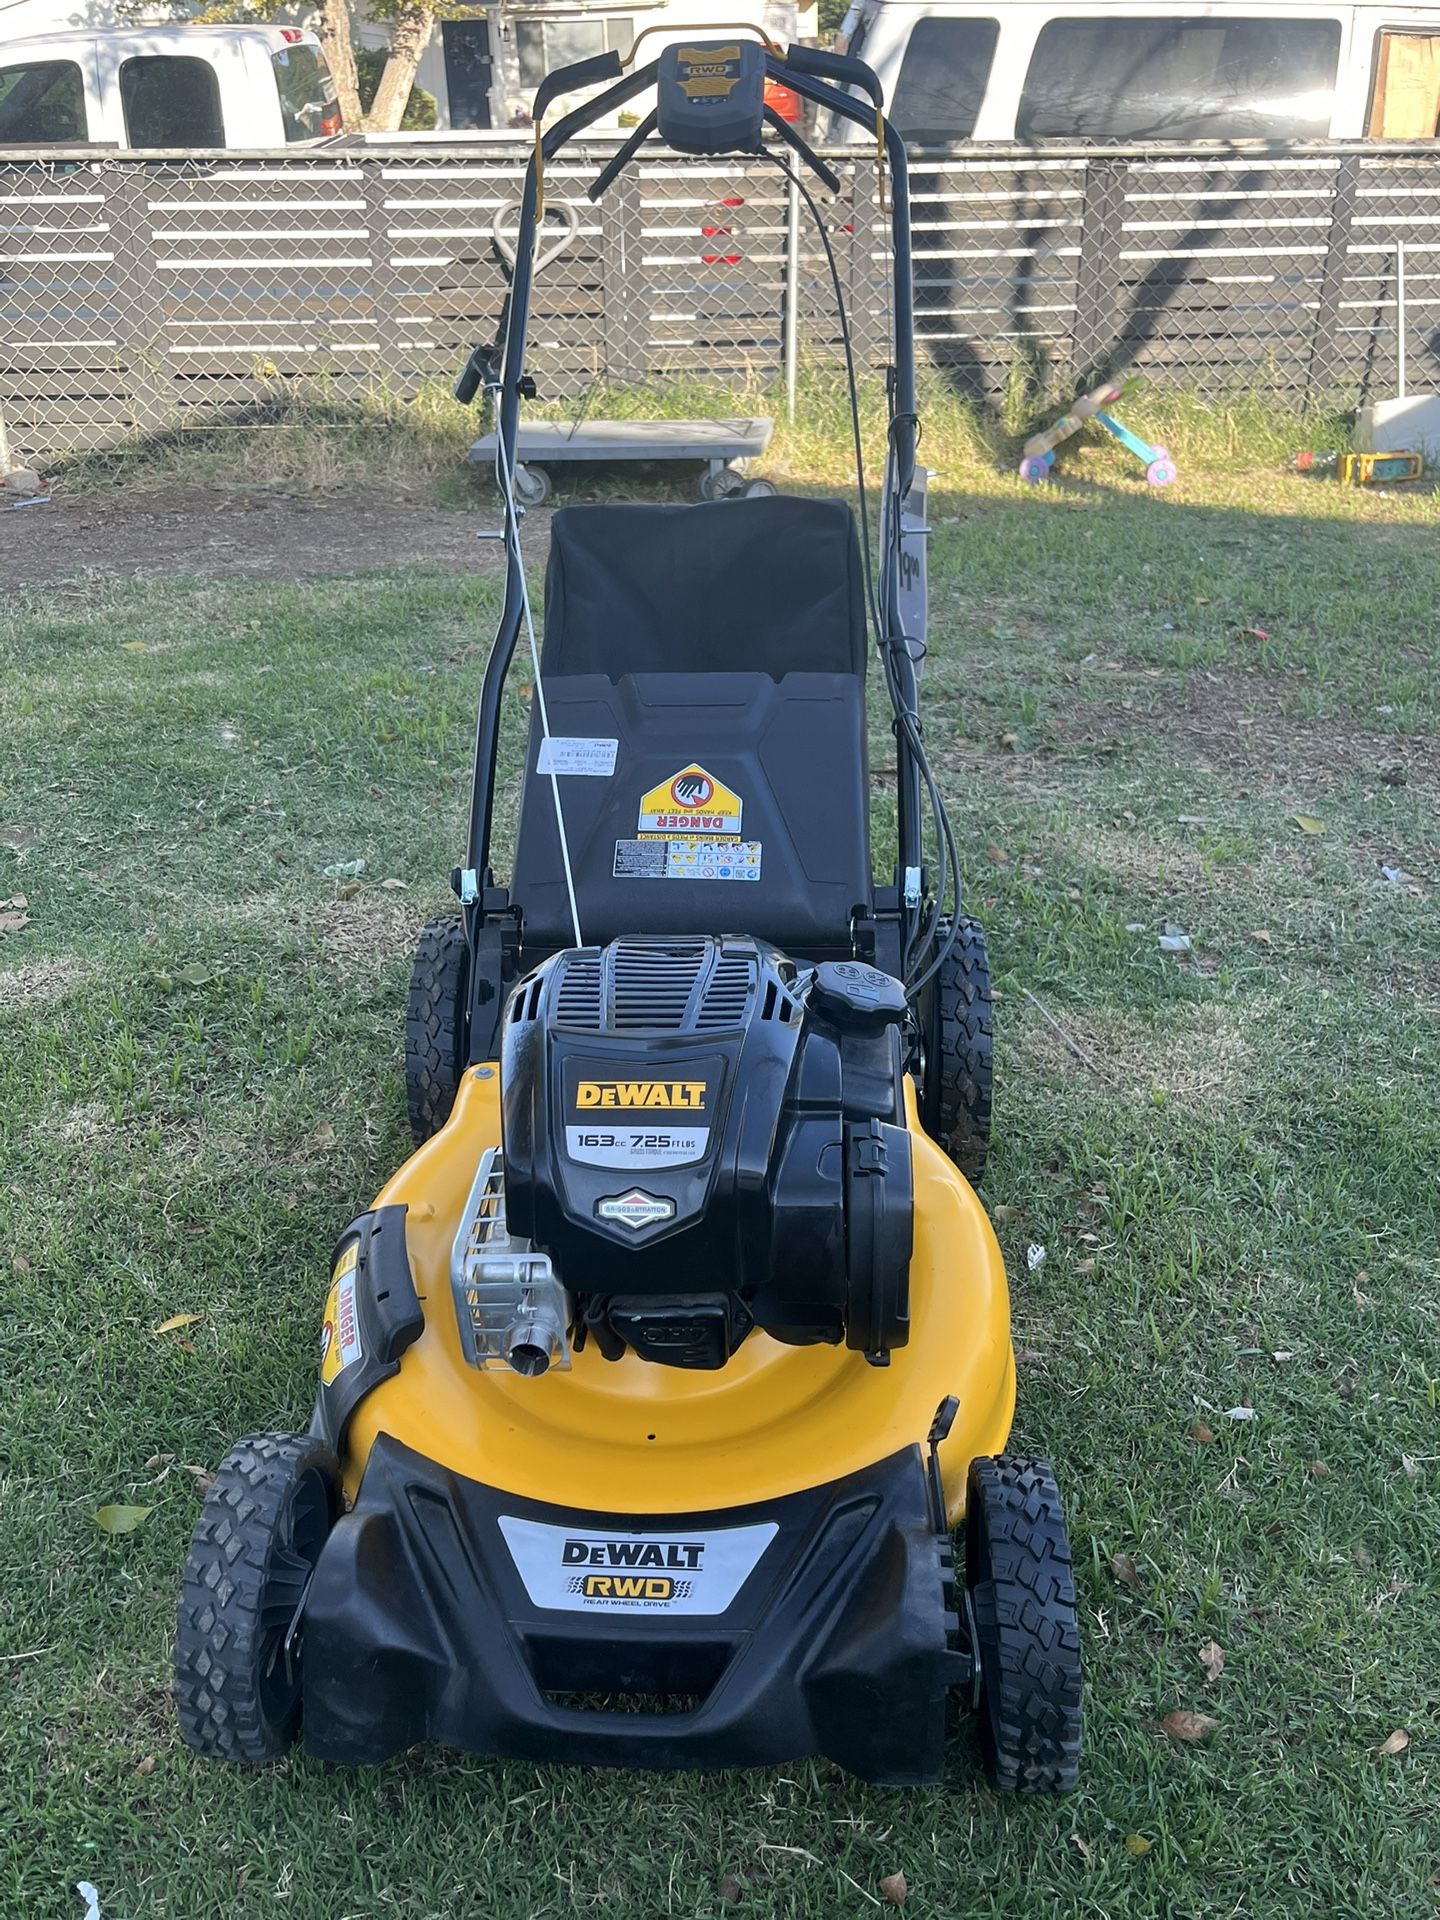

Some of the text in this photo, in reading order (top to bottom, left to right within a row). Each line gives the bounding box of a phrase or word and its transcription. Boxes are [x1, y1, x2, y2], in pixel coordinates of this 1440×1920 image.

[690, 65, 726, 74] RWD
[657, 816, 723, 828] DANGER
[576, 1083, 706, 1107] DEWALT
[578, 1135, 696, 1148] 163cc 7.25 FT LBS
[340, 1285, 355, 1349] DANGER
[562, 1542, 705, 1568] DEWALT
[587, 1576, 671, 1598] RWD
[583, 1598, 671, 1608] REAR WHEEL DRIVE
